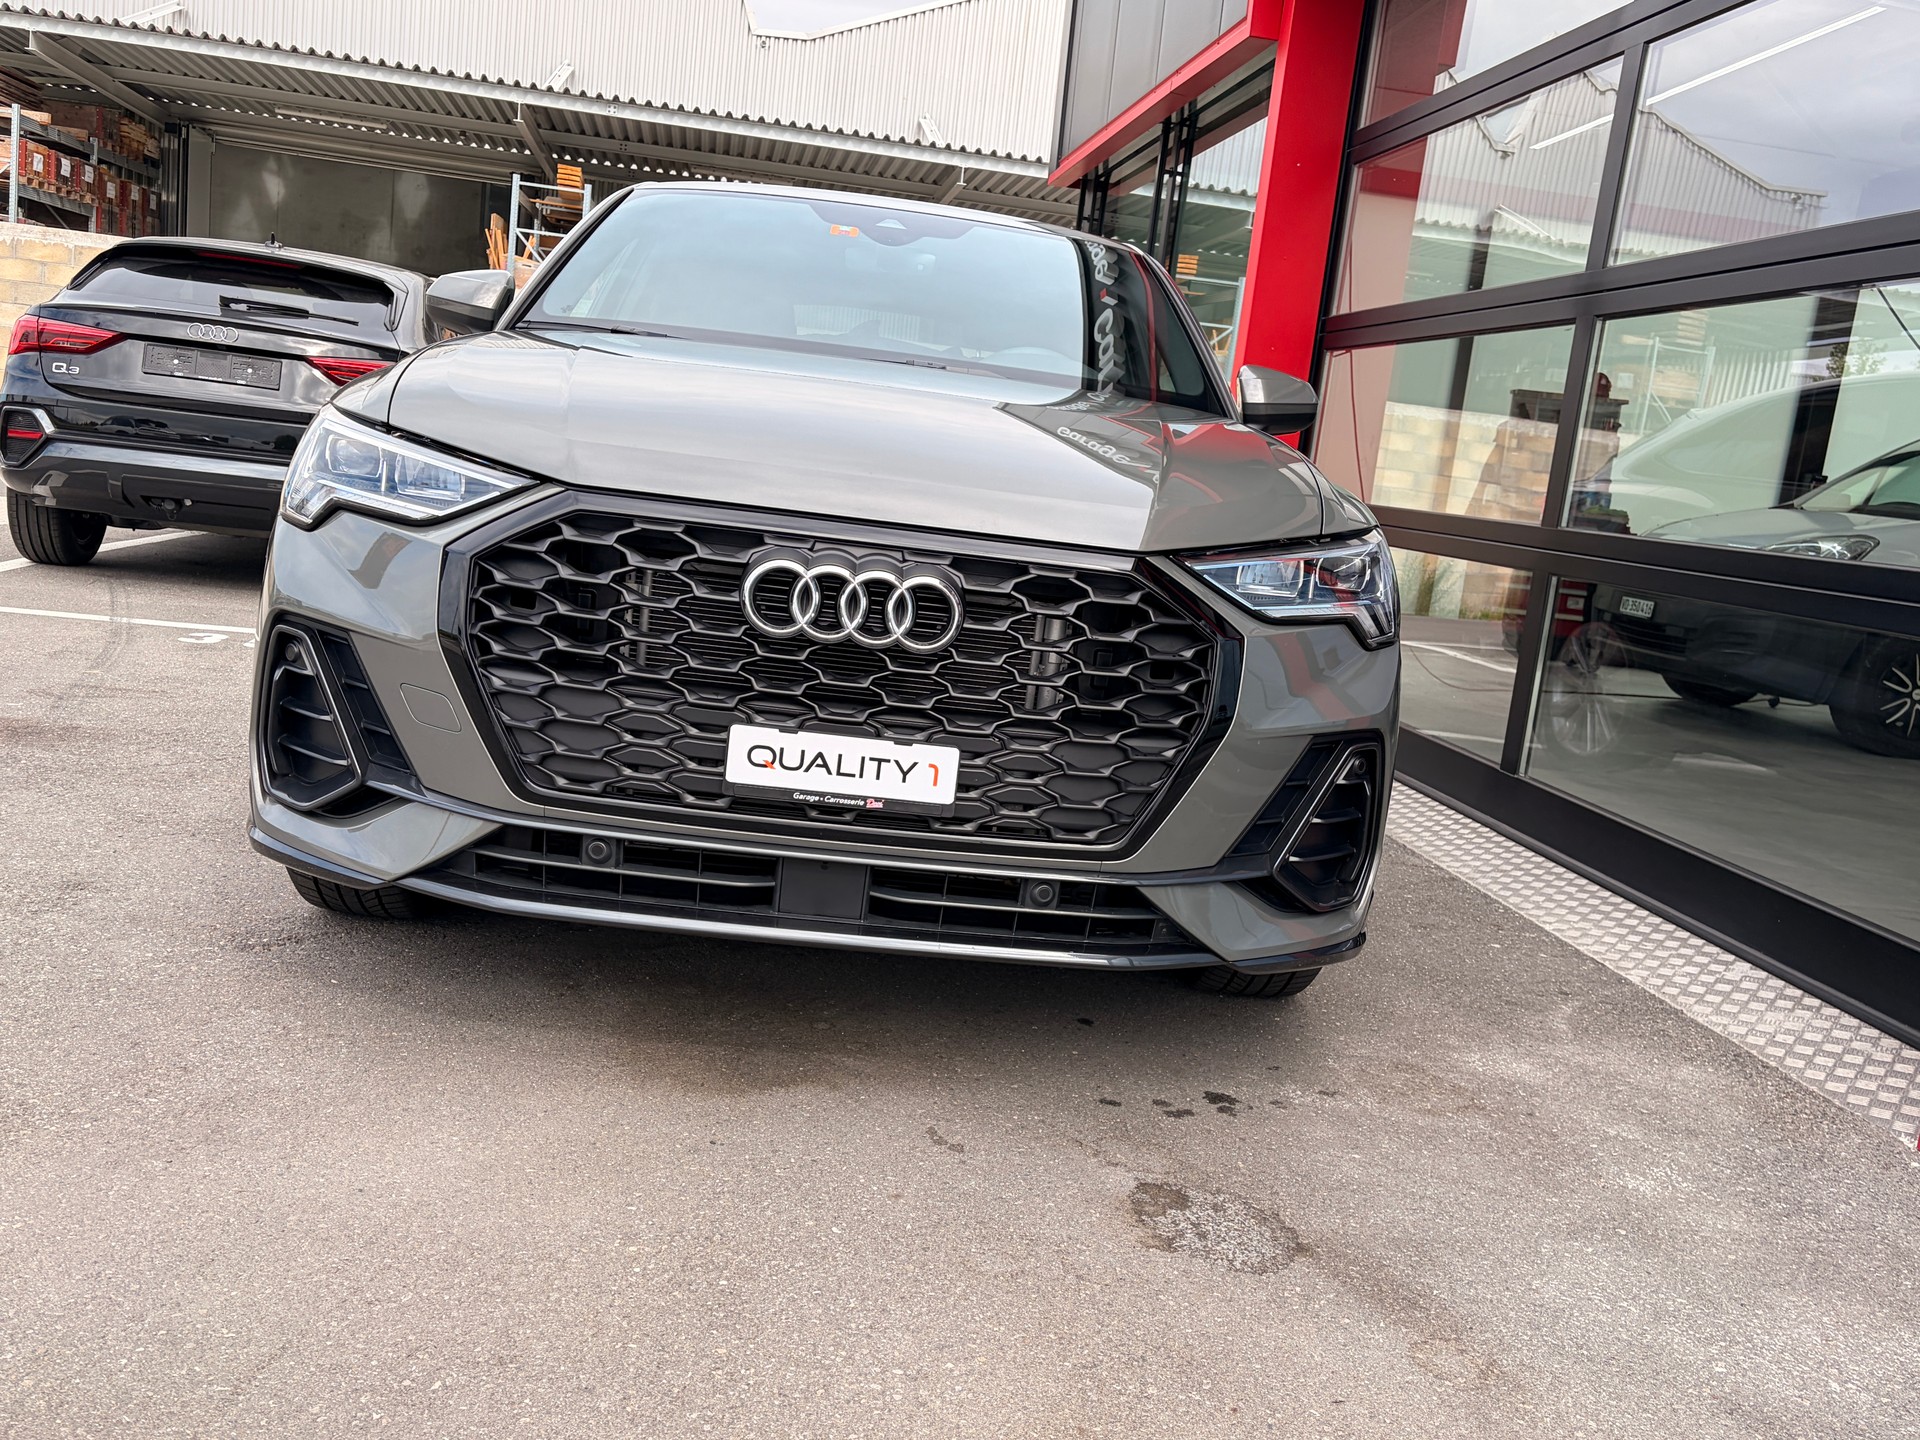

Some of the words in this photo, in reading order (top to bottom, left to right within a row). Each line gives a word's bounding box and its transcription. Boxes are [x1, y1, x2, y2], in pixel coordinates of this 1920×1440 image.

[52, 362, 80, 374] Q3
[746, 744, 919, 784] QUALITY
[928, 763, 940, 787] 1
[793, 792, 819, 802] Garage
[824, 795, 865, 806] Carrosserie
